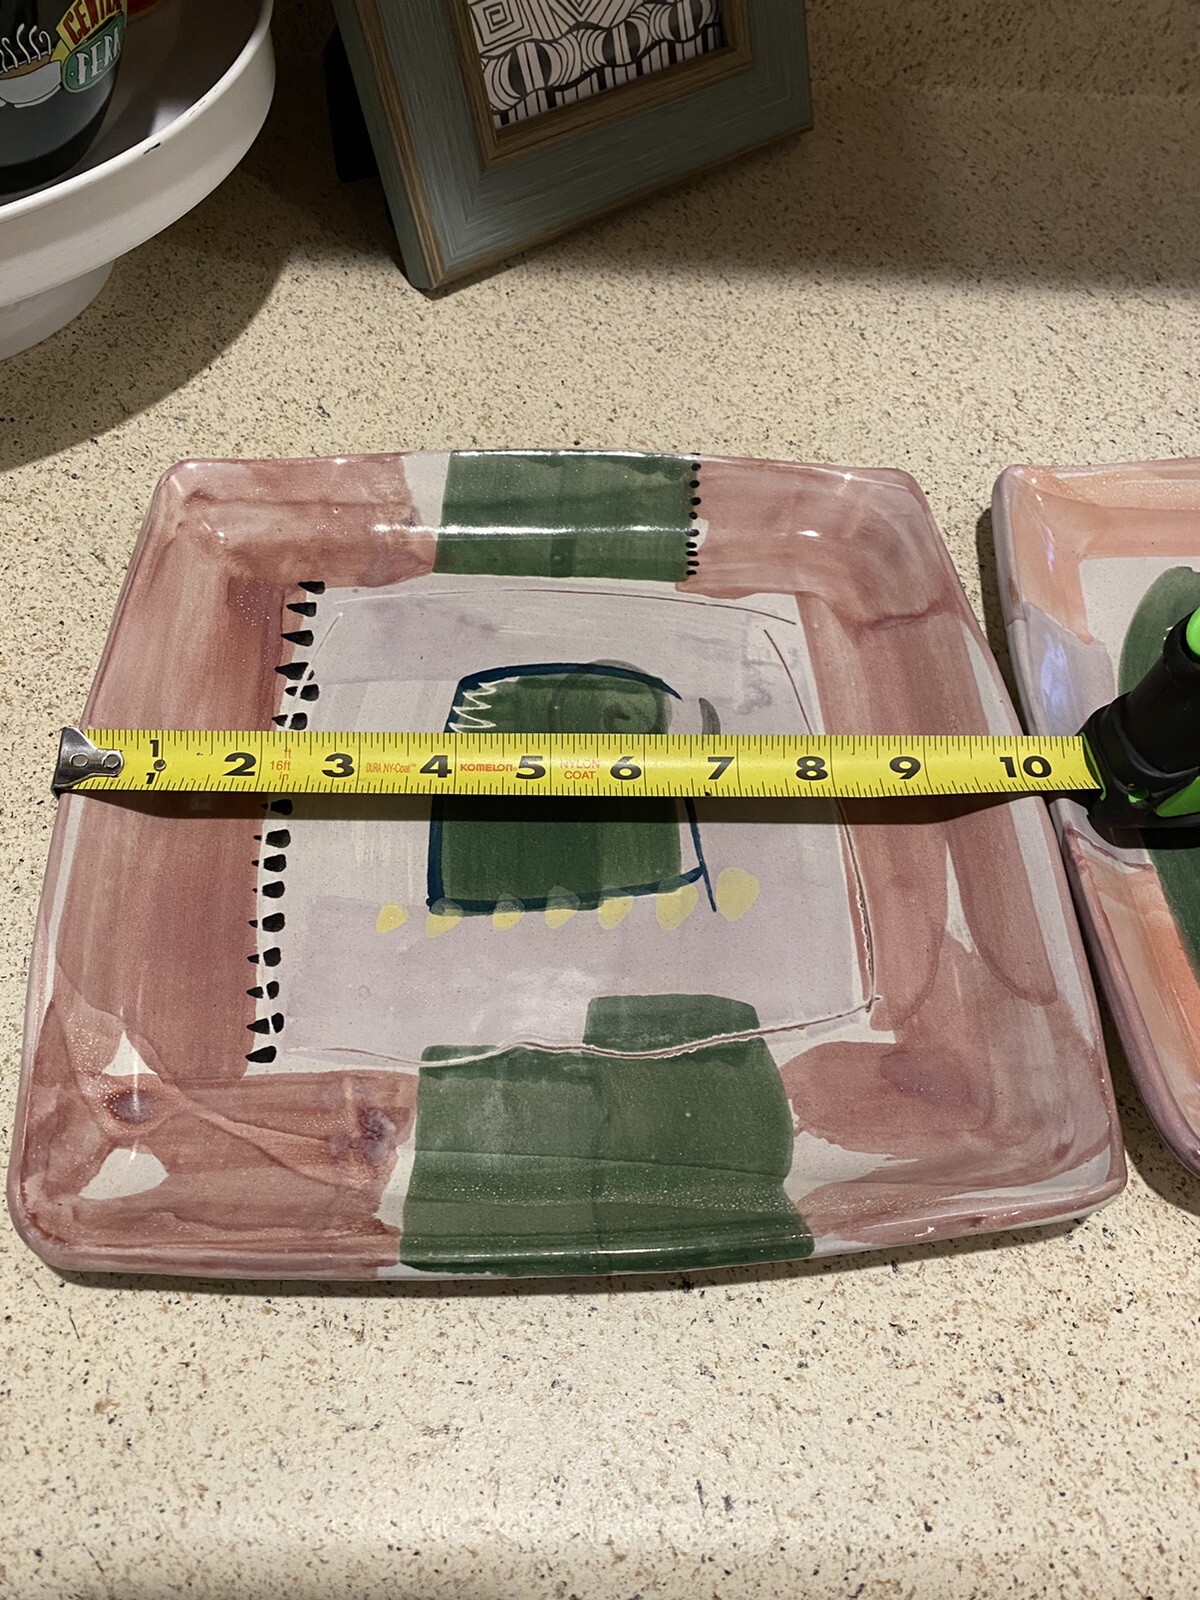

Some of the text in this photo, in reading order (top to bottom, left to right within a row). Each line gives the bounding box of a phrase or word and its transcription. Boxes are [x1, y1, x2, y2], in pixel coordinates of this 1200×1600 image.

[149, 739, 159, 758] 1
[222, 751, 257, 777] 2
[270, 760, 291, 771] 16ft
[321, 752, 355, 778] 3
[419, 754, 453, 779] 4
[515, 755, 547, 780] 5
[560, 759, 600, 769] NYLON
[564, 770, 596, 780] COAT
[609, 755, 642, 781] 6
[707, 756, 736, 781] 7
[795, 755, 829, 781] 8
[889, 756, 922, 780] 9
[999, 755, 1053, 779] 10
[145, 772, 156, 785] 1
